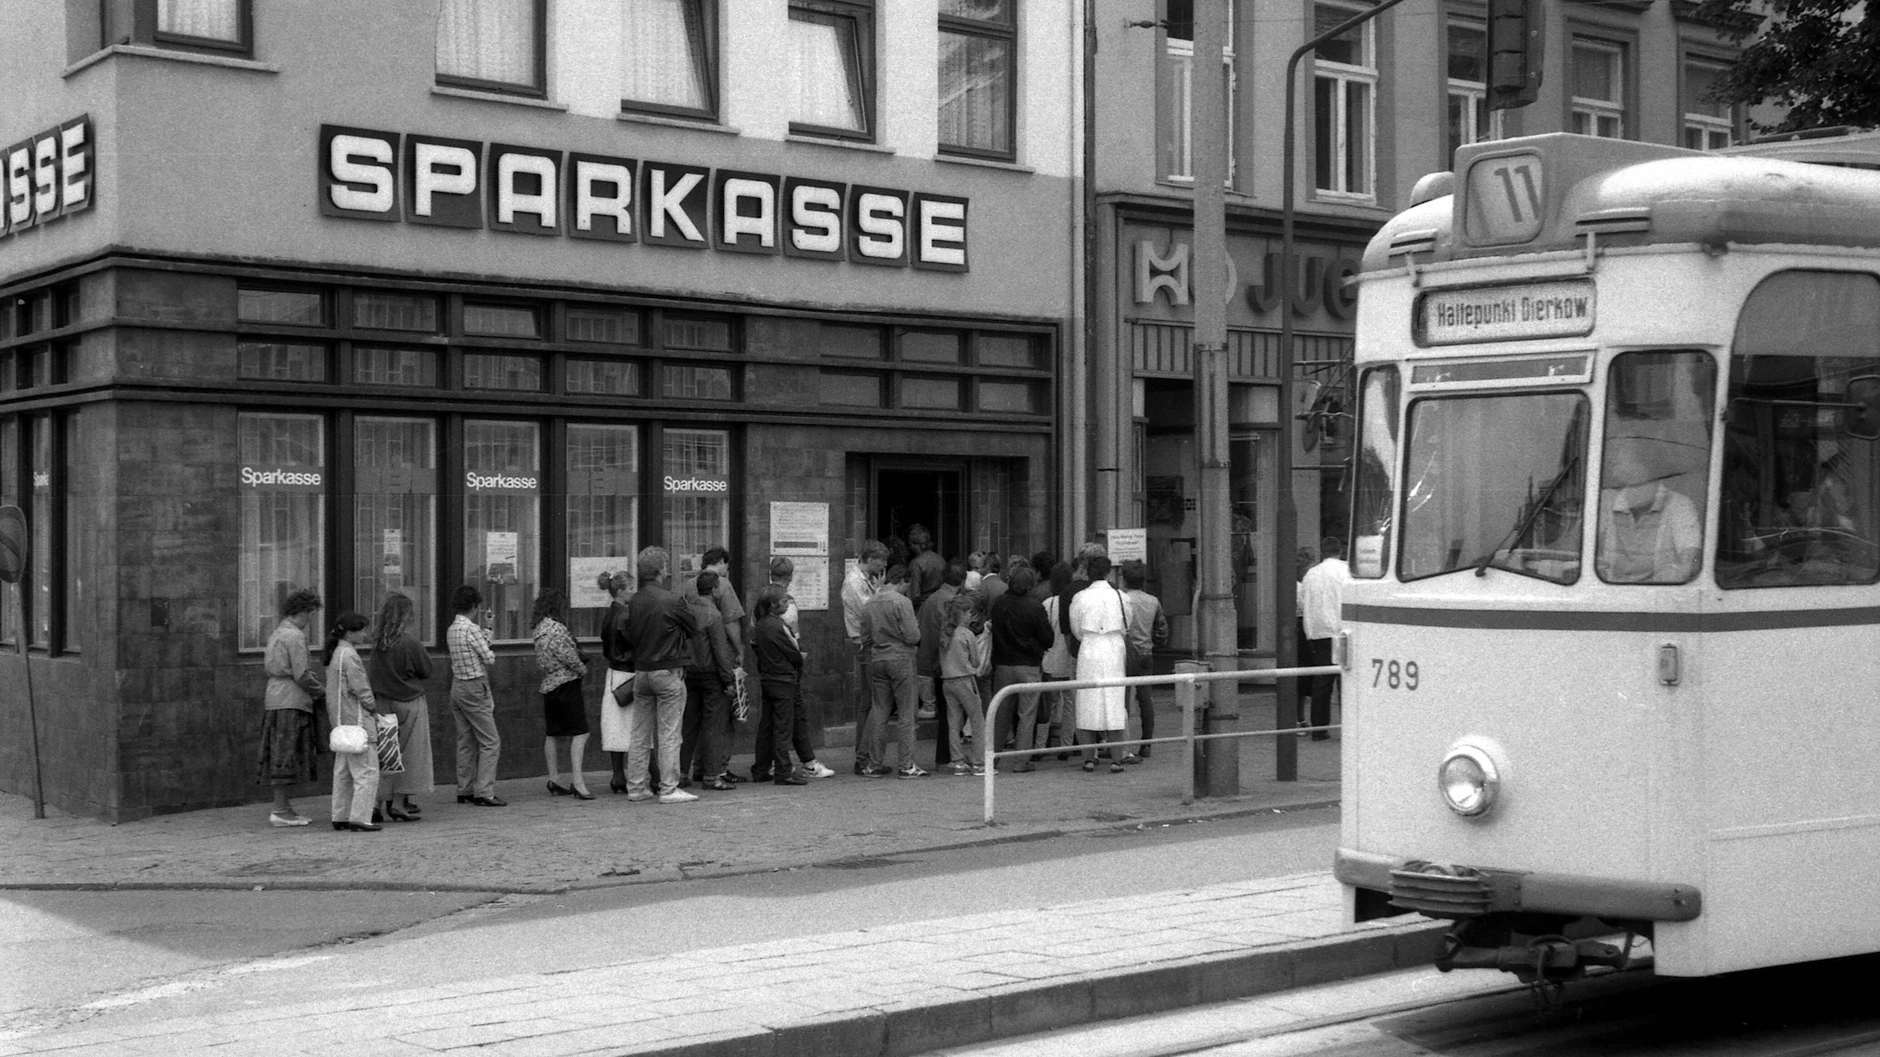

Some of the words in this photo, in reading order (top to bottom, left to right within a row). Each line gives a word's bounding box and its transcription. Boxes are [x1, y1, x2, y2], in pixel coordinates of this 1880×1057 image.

[0, 122, 85, 230] SSE
[330, 133, 965, 265] SPARKASSE
[1493, 165, 1541, 223] 11
[1521, 297, 1589, 322] Dierkow
[241, 466, 321, 488] Sparkasse
[466, 471, 537, 491] Sparkasse
[663, 475, 727, 493] Sparkasse
[1371, 658, 1419, 691] 789
